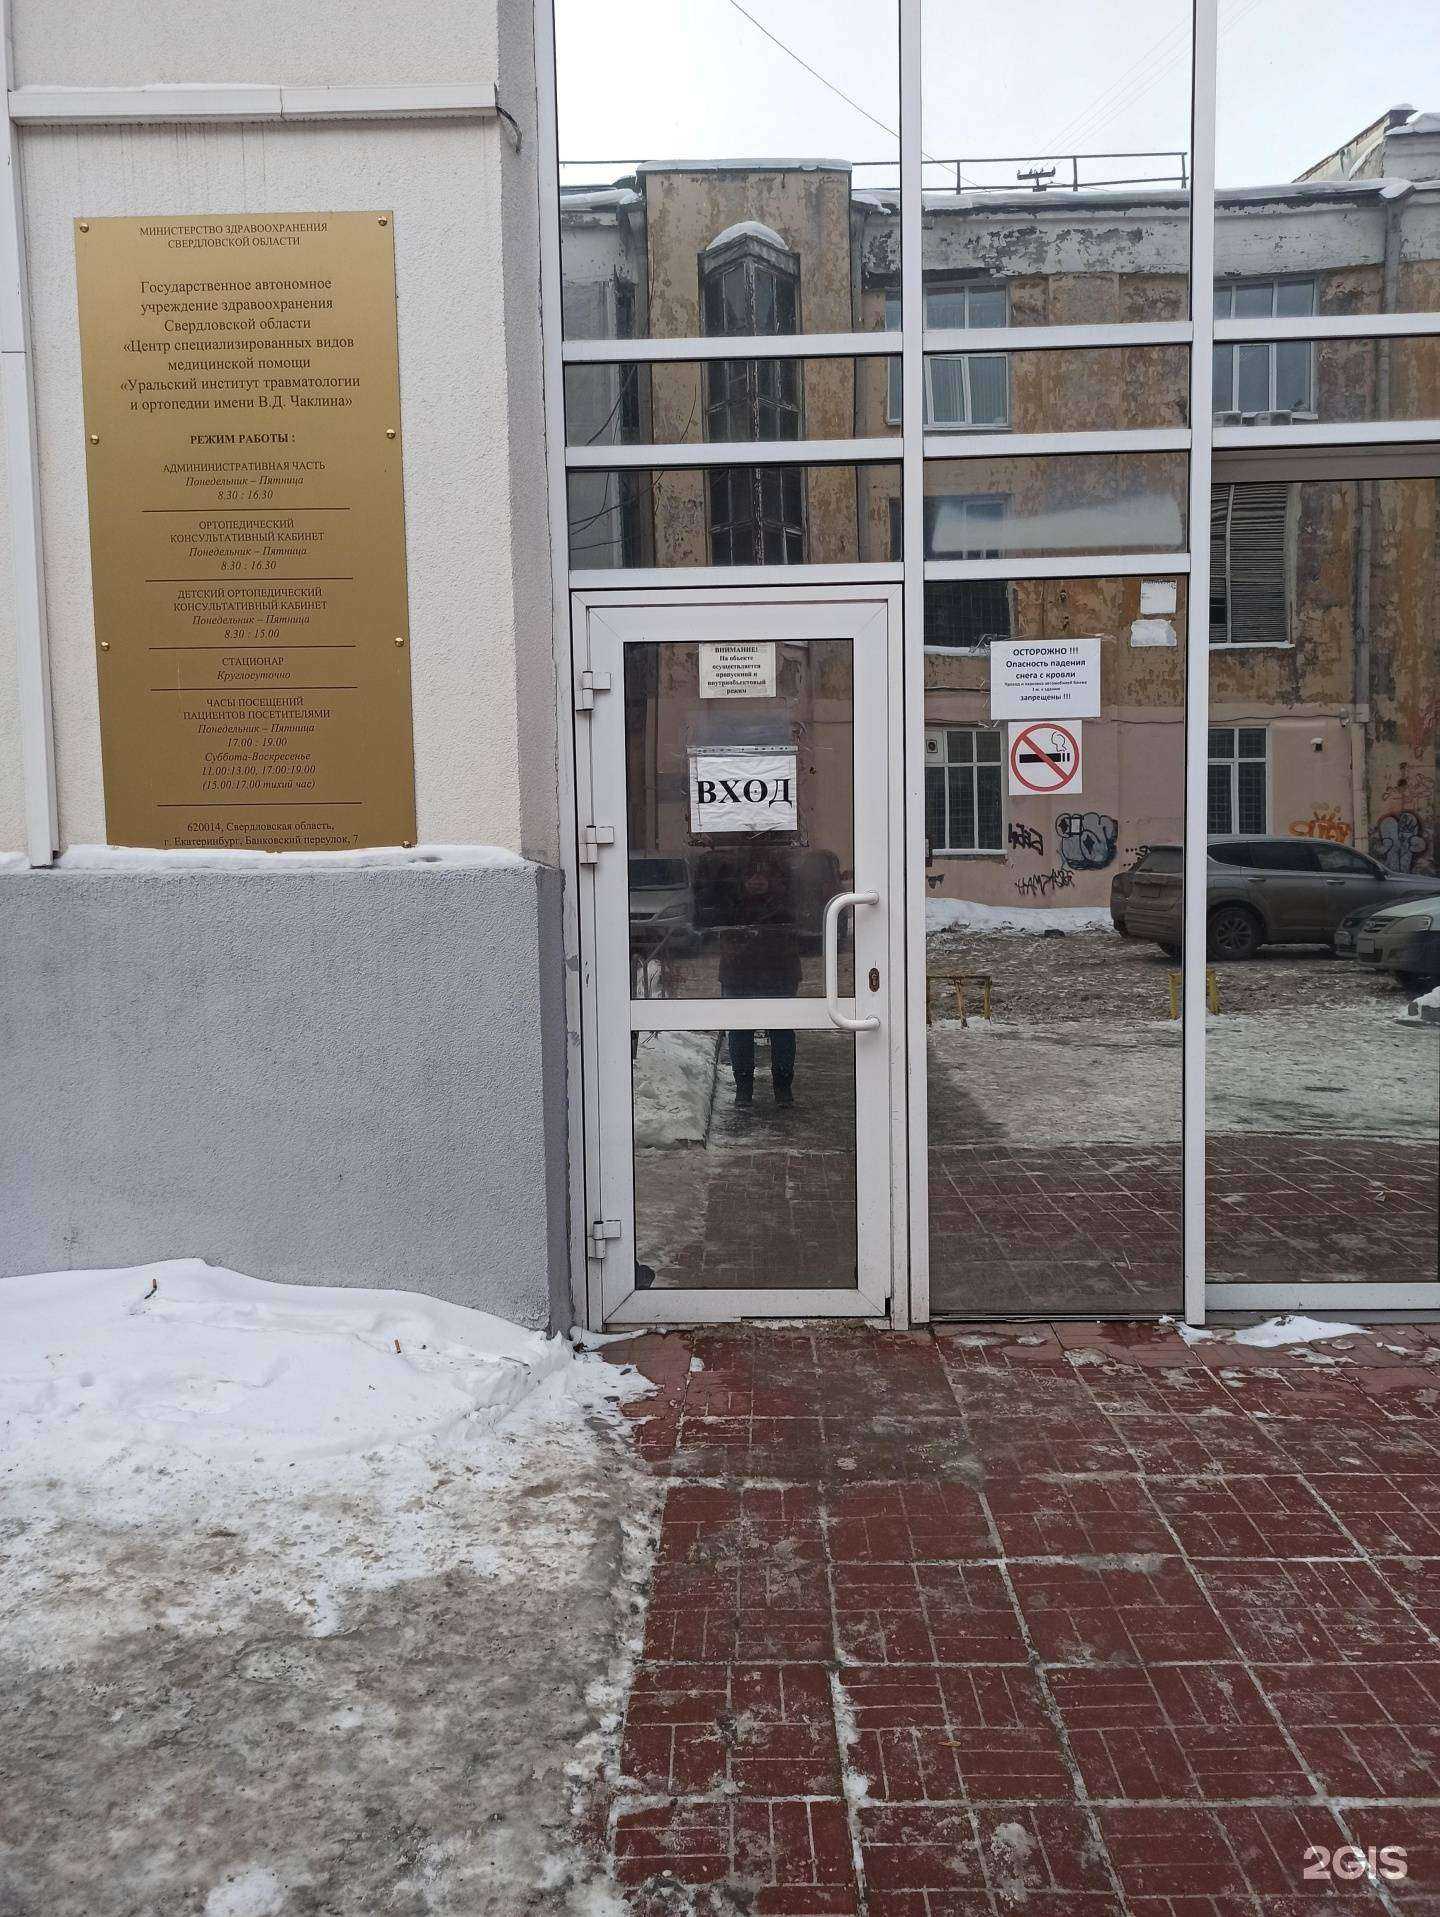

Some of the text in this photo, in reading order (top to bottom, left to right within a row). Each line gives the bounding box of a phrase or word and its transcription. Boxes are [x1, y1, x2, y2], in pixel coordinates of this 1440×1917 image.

[140, 223, 328, 236] МИНИСТЕРСТВО ЗДРАВООХРАНЕНИЯ
[168, 237, 300, 248] СВЕРДЛОВСКОЙ ОБЛАСТИ
[141, 279, 332, 294] Государственное автономное
[140, 299, 333, 315] учреждение здравоохранения
[164, 318, 311, 332] Свердловской области
[123, 338, 354, 354] «Центр специализированных видов
[168, 358, 311, 371] медицинской помощи
[121, 377, 360, 392] «Уральский институт травматологии
[130, 395, 352, 411] и ортопедии имени В.Д. Чаклина»
[190, 434, 235, 444] РЕЖИМ
[238, 434, 289, 444] РАБОТЫ
[292, 461, 325, 471] ЧАСТЬ
[186, 477, 248, 487] Понедельник
[259, 476, 304, 485] Пятница
[217, 490, 237, 500] 8.30
[247, 489, 273, 500] 16.30
[199, 518, 294, 531] ОРТОПЕДИЧЕСКИЙ
[170, 531, 325, 543] КОНСУЛЬТАТИВНЫЙ КАБИНЕТ
[189, 548, 251, 557] Понедельник
[263, 546, 307, 556] Пятница
[221, 561, 241, 571] 8.30
[251, 560, 277, 570] 16.30
[178, 586, 322, 600] ДЕТСКИЙ ОРТОПЕДИЧЕСКИЙ
[174, 601, 327, 612] КОНСУЛЬТАТИВНЫЙ КАБИНЕТ
[192, 616, 255, 626] Понедельник
[266, 615, 310, 624] Пятница
[224, 629, 244, 639] 8.30
[254, 629, 280, 639] 15.00
[222, 656, 284, 667] СТАЦИОНАР
[1006, 660, 1048, 668] Опасность
[217, 670, 291, 681] Круглосуточно
[206, 696, 304, 708] ЧАСЫ ПОСЕЩЕНИЙ
[183, 709, 330, 721] ПАЦИЕНТОВ ПОСЕТИТЕЛЯМИ
[198, 724, 260, 734] Понедельник
[271, 723, 315, 733] Пятница
[226, 738, 253, 748] 17.00
[262, 737, 287, 747] 19.00
[205, 751, 311, 763] Суббота-Воскресенье
[262, 779, 294, 789] тихий
[295, 779, 316, 790] час)
[696, 778, 792, 808] ВХОД
[187, 821, 335, 833] 620014, Свердловская область,
[175, 836, 242, 849] Екатеринбург,
[245, 834, 302, 845] Банковский
[304, 835, 351, 847] переулок,
[353, 834, 359, 844] 7
